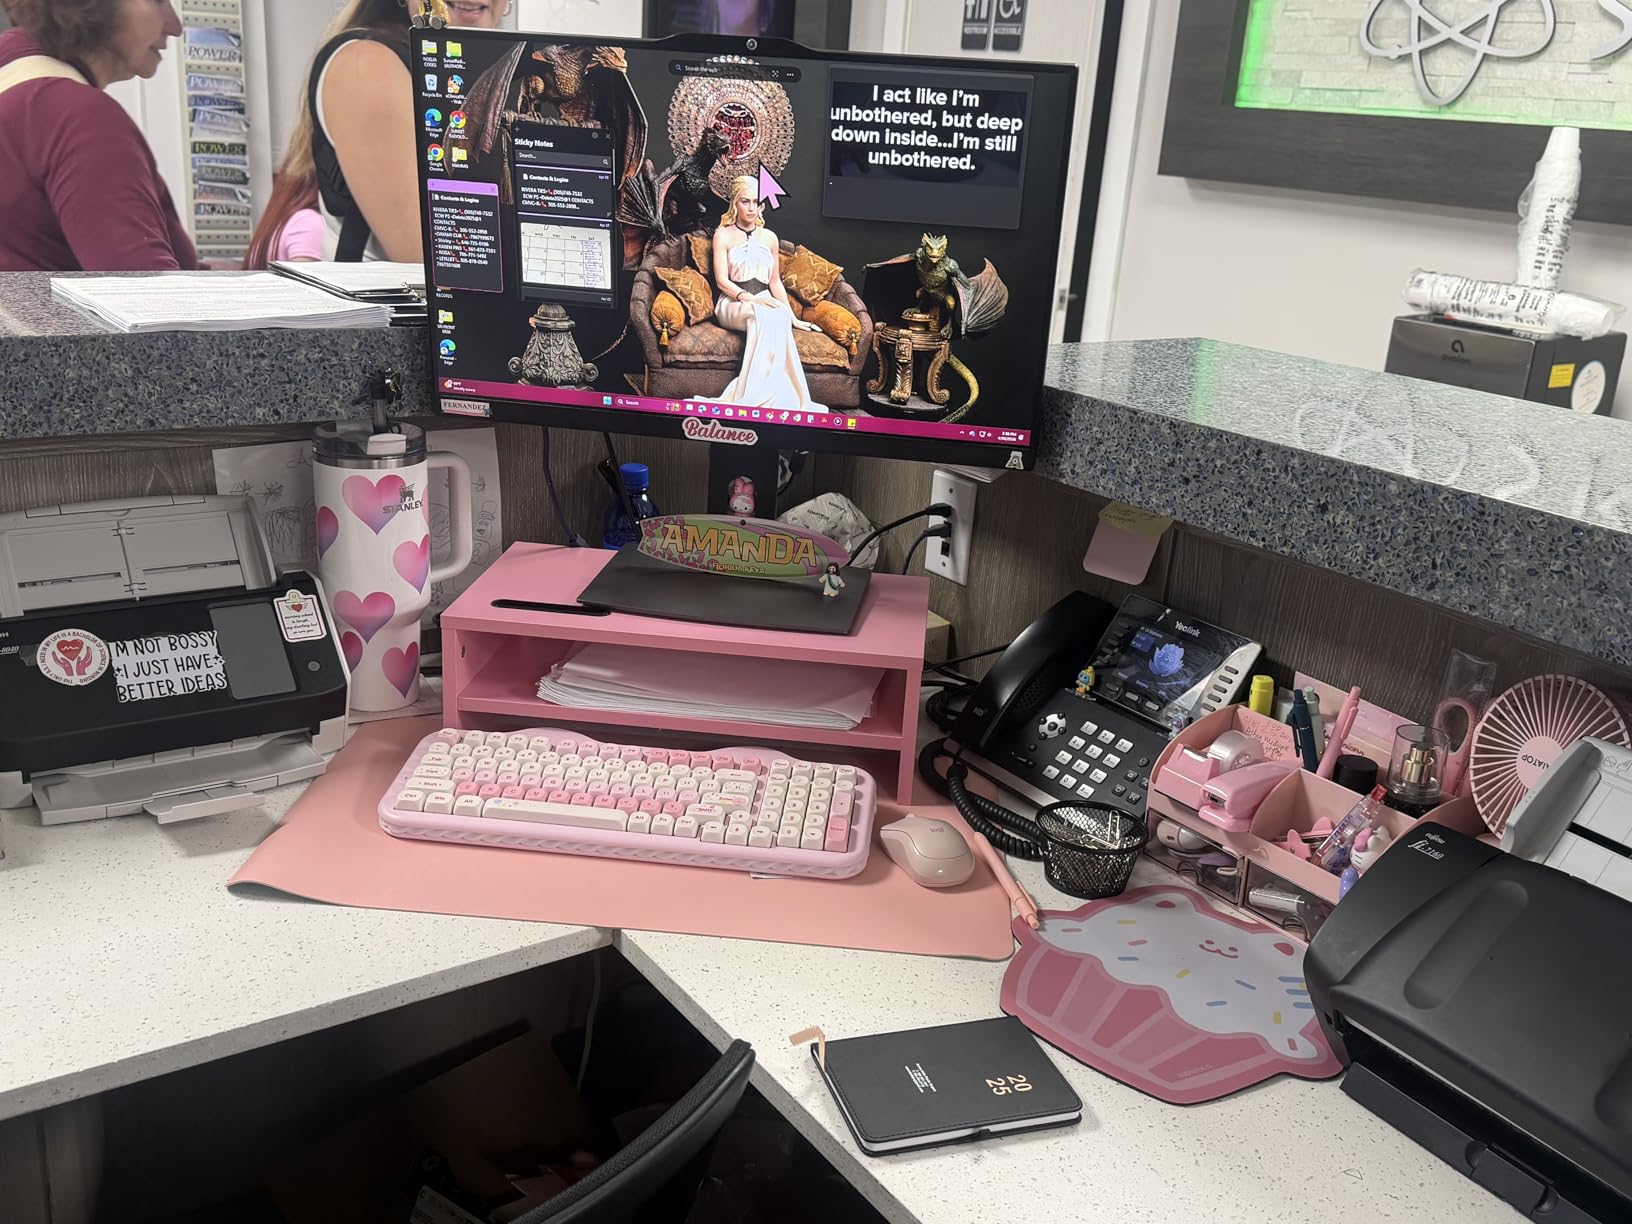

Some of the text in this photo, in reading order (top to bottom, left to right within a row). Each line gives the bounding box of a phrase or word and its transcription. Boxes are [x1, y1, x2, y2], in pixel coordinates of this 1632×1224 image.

[873, 85, 878, 101] I
[883, 88, 911, 104] act
[916, 88, 947, 105] like
[831, 105, 1023, 134] unbothered, but deep
[515, 139, 533, 147] Sticky
[831, 126, 880, 143] down
[985, 135, 1017, 152] still
[869, 150, 976, 170] unbothered.
[444, 402, 486, 410] FERNANDEZ
[685, 418, 756, 444] Balance
[382, 499, 423, 514] STANLEY
[661, 523, 817, 567] AMANDA
[1175, 621, 1200, 638] Yealink
[134, 638, 161, 655] NOT
[168, 631, 216, 651] BOSSY
[123, 654, 213, 678] I JUST HAVE
[117, 673, 226, 702] BETTER IDEAS
[985, 1077, 1012, 1096] 25
[1006, 1074, 1032, 1092] 20
